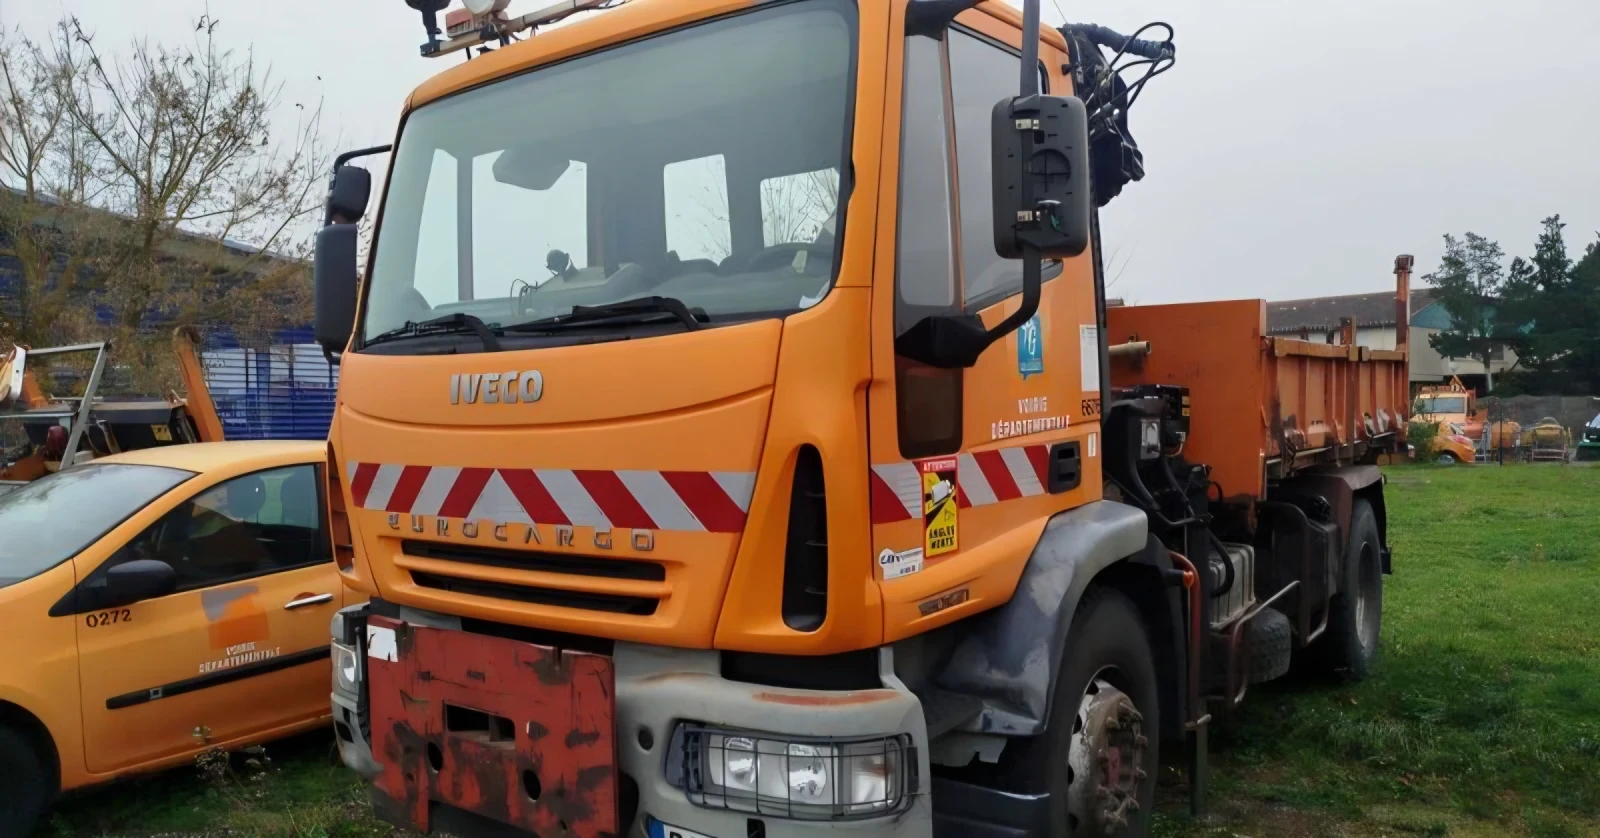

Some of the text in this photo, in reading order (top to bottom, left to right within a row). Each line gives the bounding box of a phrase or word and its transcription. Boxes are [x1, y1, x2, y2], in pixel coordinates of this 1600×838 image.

[450, 369, 544, 405] IVECO
[388, 511, 655, 551] EUROCARGO
[86, 609, 132, 628] 0272
